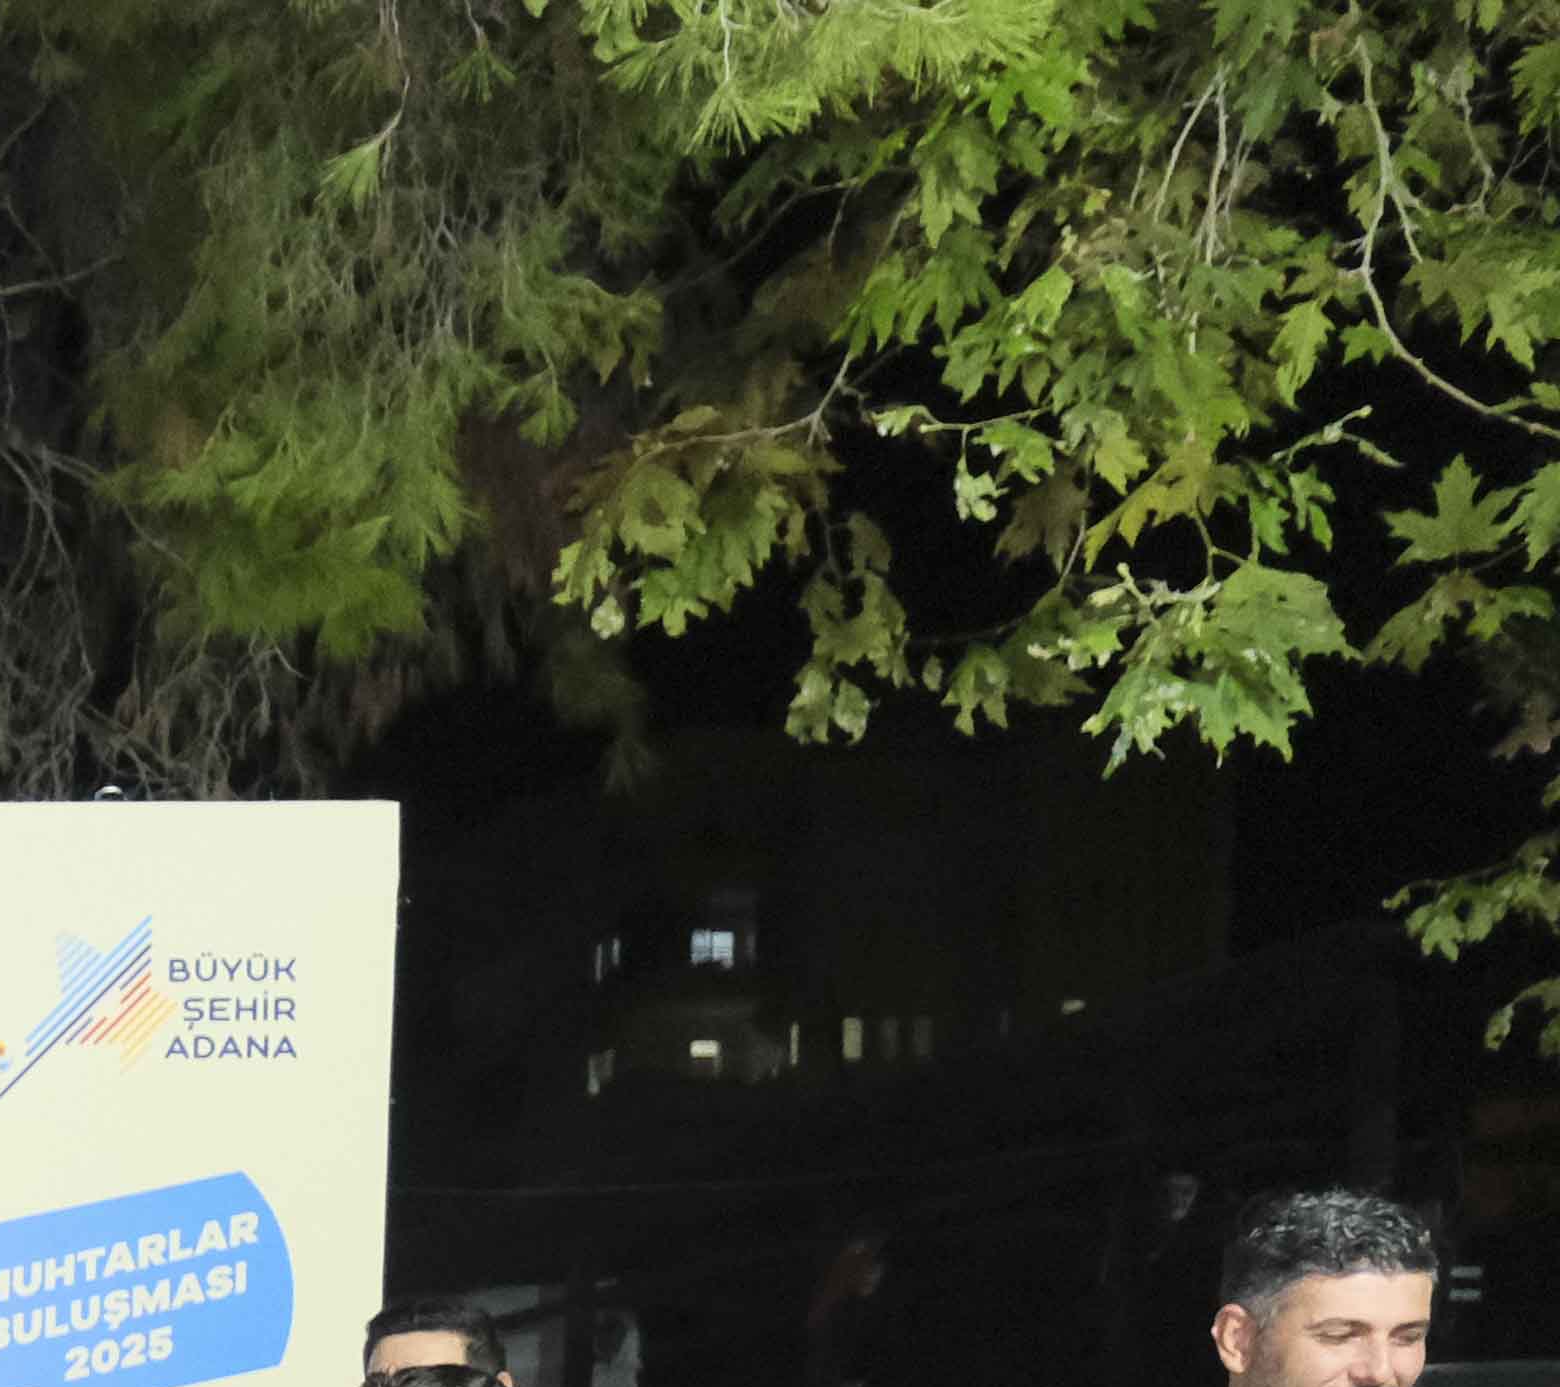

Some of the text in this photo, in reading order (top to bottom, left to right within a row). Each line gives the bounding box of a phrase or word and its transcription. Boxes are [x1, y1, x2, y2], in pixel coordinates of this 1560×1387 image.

[169, 952, 296, 982] BÜYÜK
[183, 990, 296, 1030] ŞEHİR
[165, 1036, 297, 1059] ADANA
[64, 1326, 173, 1381] 2025
